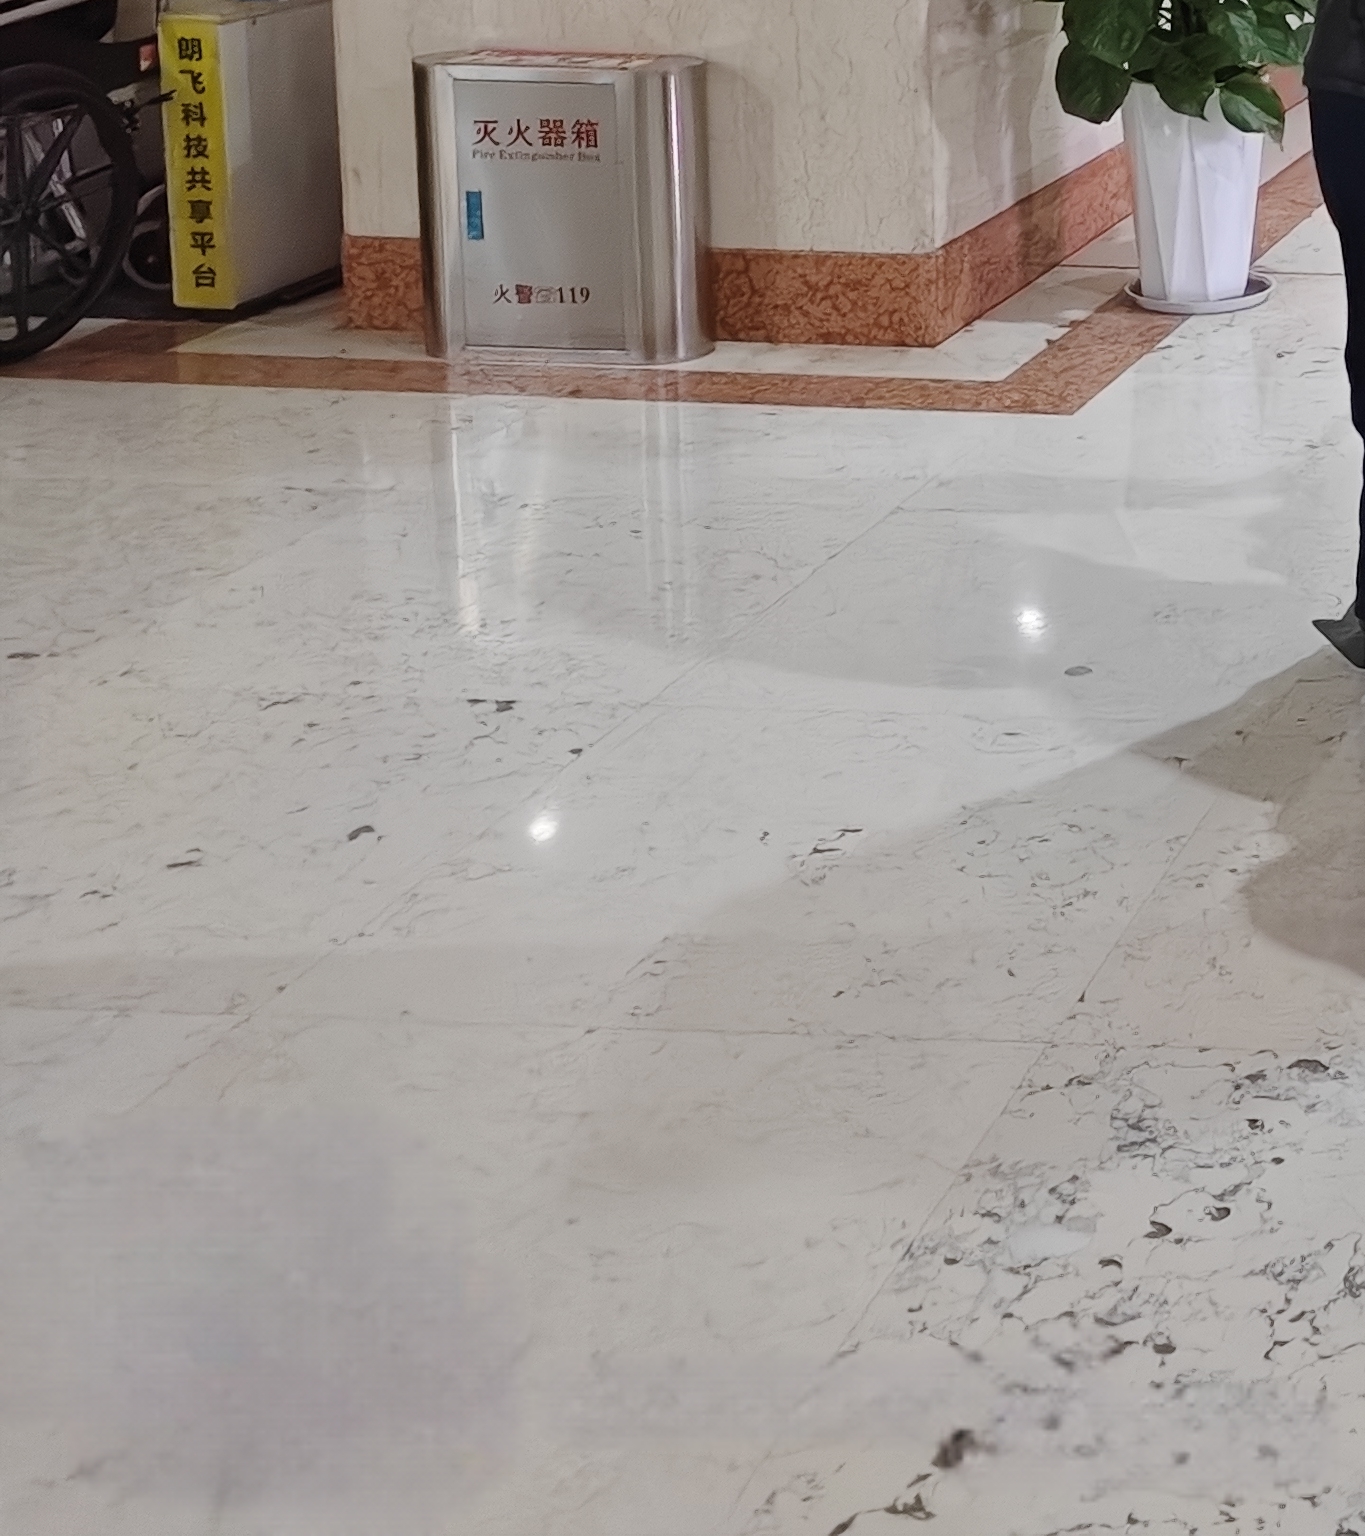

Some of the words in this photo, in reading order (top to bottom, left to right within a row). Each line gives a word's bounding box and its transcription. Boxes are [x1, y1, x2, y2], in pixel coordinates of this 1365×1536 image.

[177, 37, 217, 288] 朗飞科技共享平台
[472, 118, 599, 149] 灭火器箱
